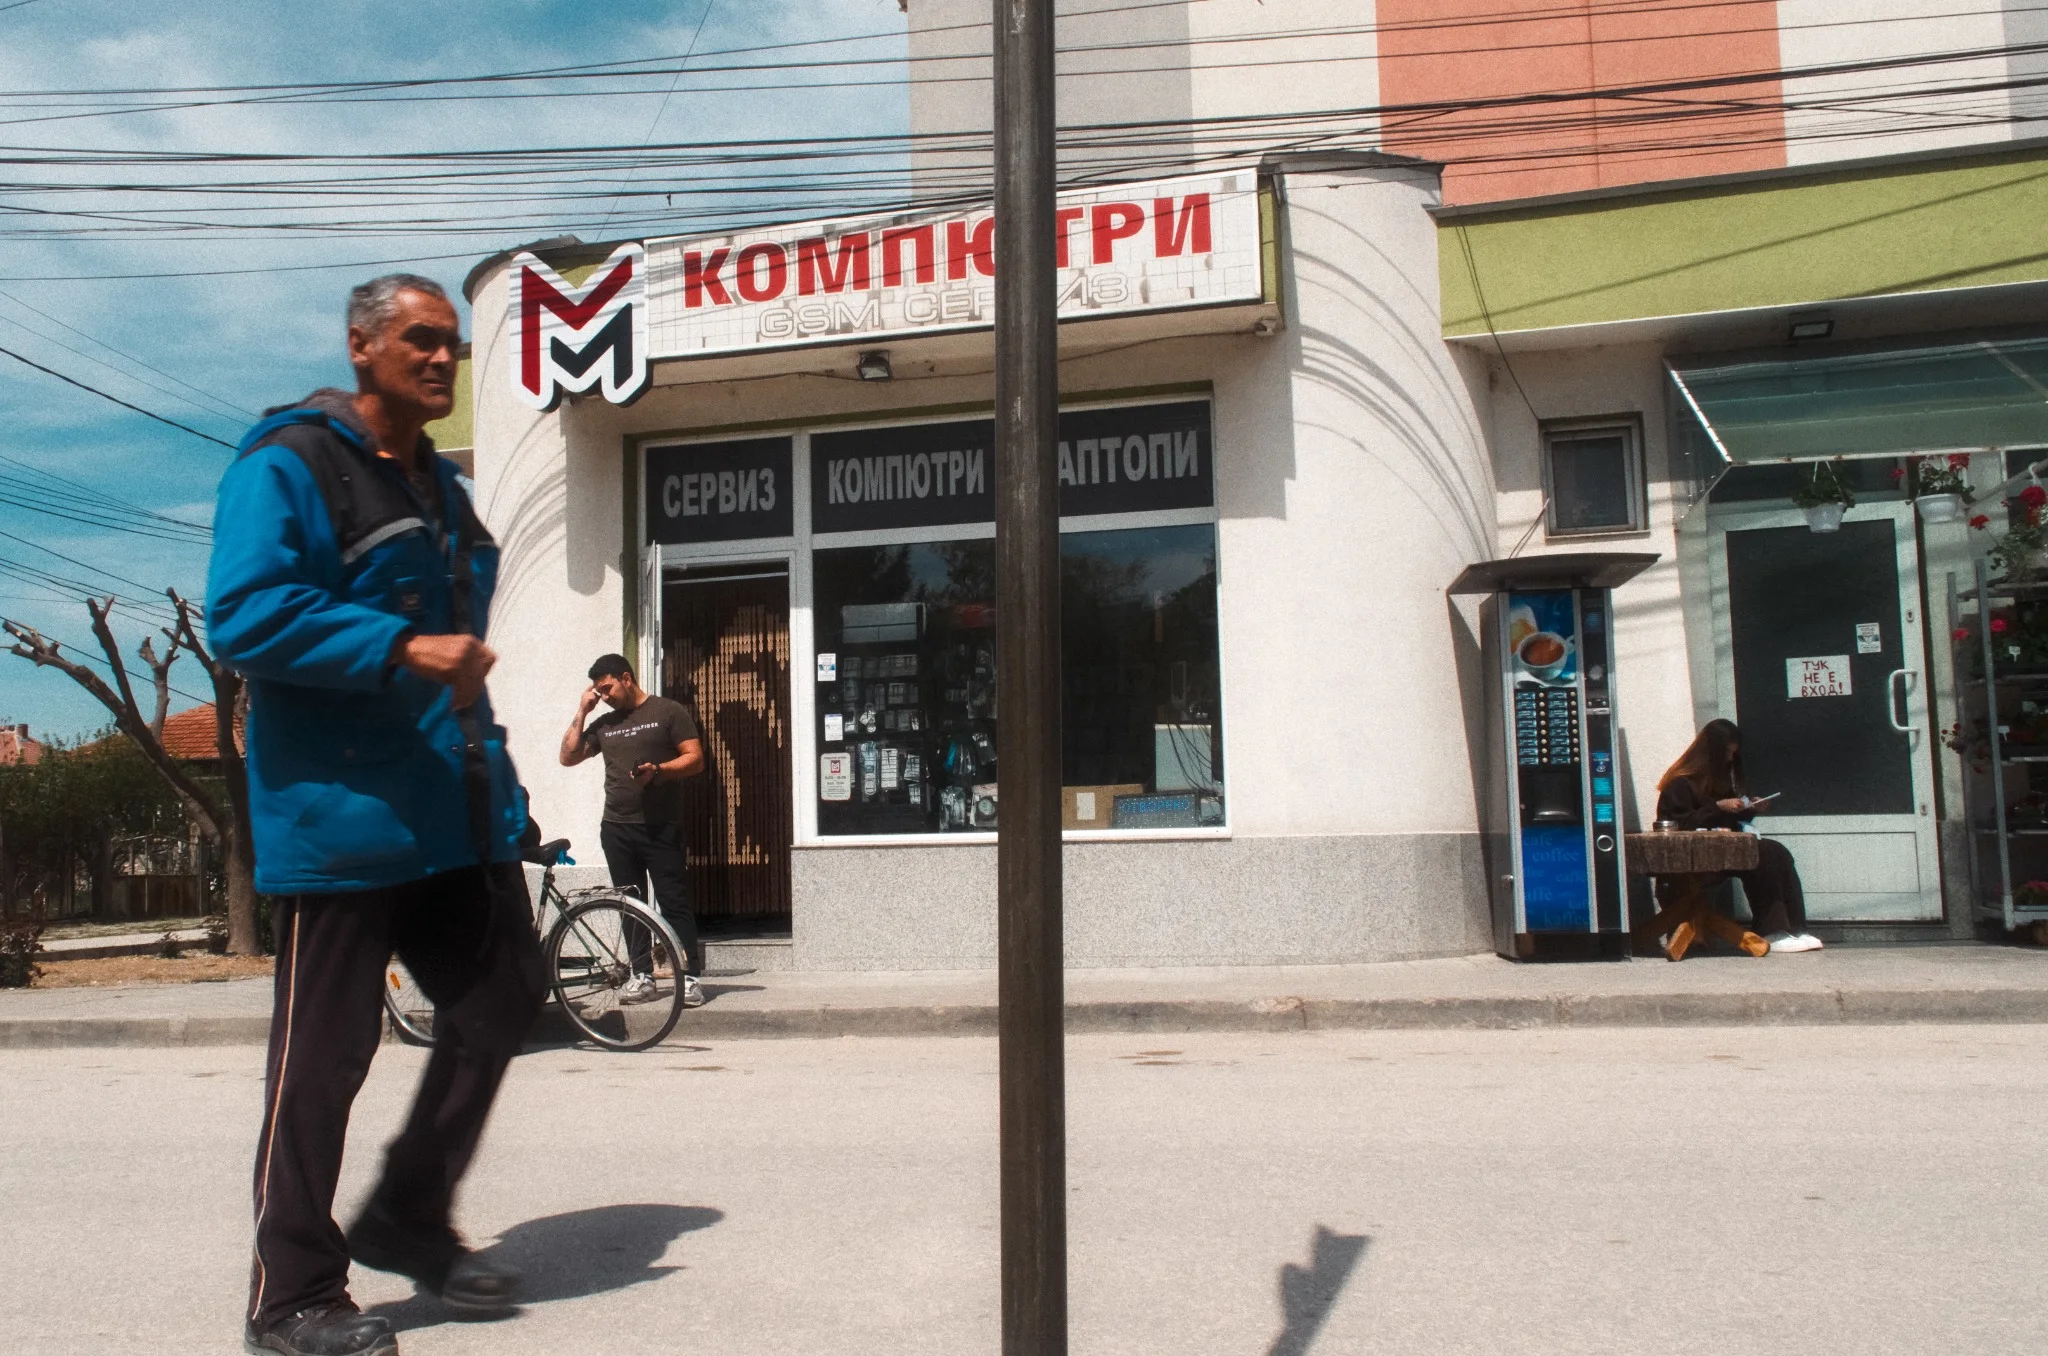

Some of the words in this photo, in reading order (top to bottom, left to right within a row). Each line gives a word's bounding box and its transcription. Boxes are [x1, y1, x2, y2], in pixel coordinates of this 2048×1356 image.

[684, 193, 1212, 308] КОМПЮТРИ
[759, 299, 881, 337] GSM
[904, 272, 1128, 324] СЕРИЗ
[828, 449, 984, 504] КОМПЮТРИ
[1058, 430, 1198, 486] АПТОПИ
[663, 468, 776, 518] СЕРВИЗ
[1801, 682, 1843, 697] ВХОД!
[1802, 660, 1829, 671] ТУК
[1804, 672, 1820, 683] НЕ
[1828, 671, 1835, 683] Е
